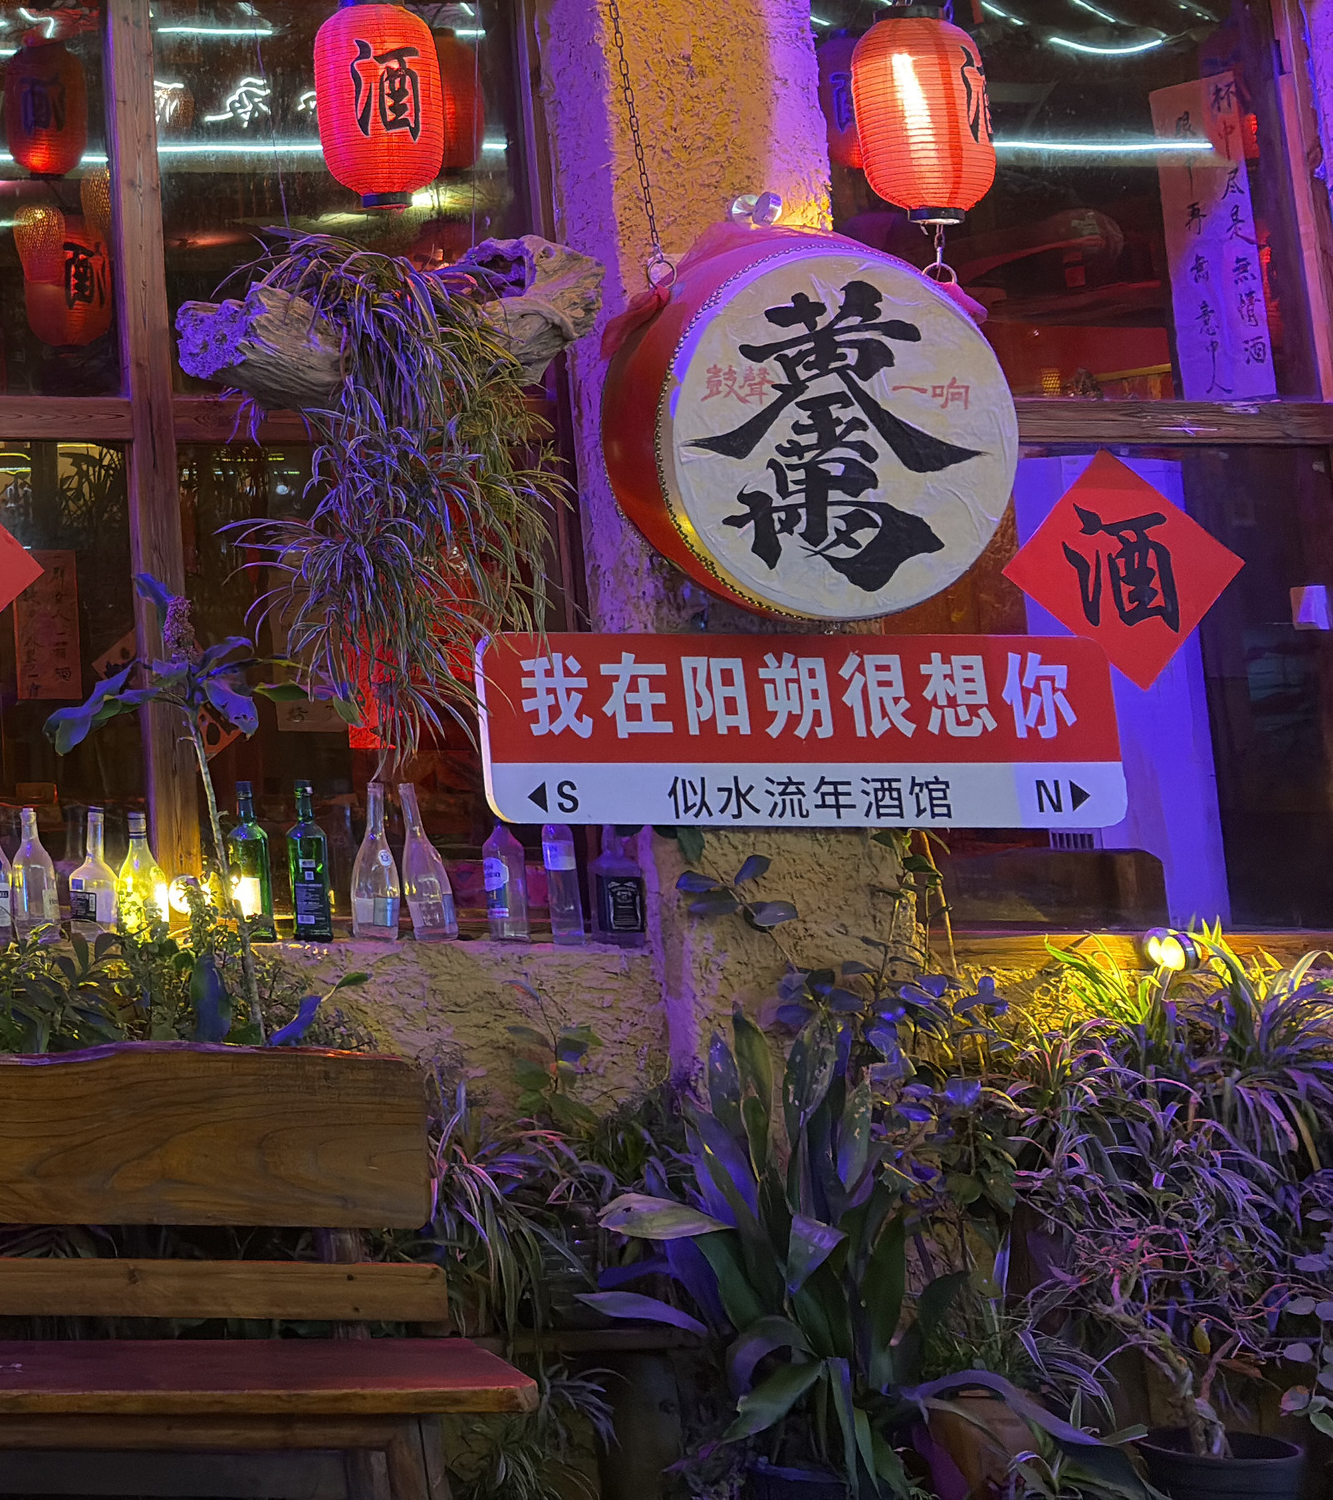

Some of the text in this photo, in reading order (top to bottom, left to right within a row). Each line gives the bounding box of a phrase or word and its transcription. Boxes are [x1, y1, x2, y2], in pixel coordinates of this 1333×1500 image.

[350, 40, 421, 142] 酒
[1063, 503, 1180, 633] 酒
[520, 651, 1078, 742] 我在阳朔很想你
[557, 782, 579, 813] S
[666, 774, 953, 821] 似水流年酒馆
[1037, 780, 1062, 812] N
